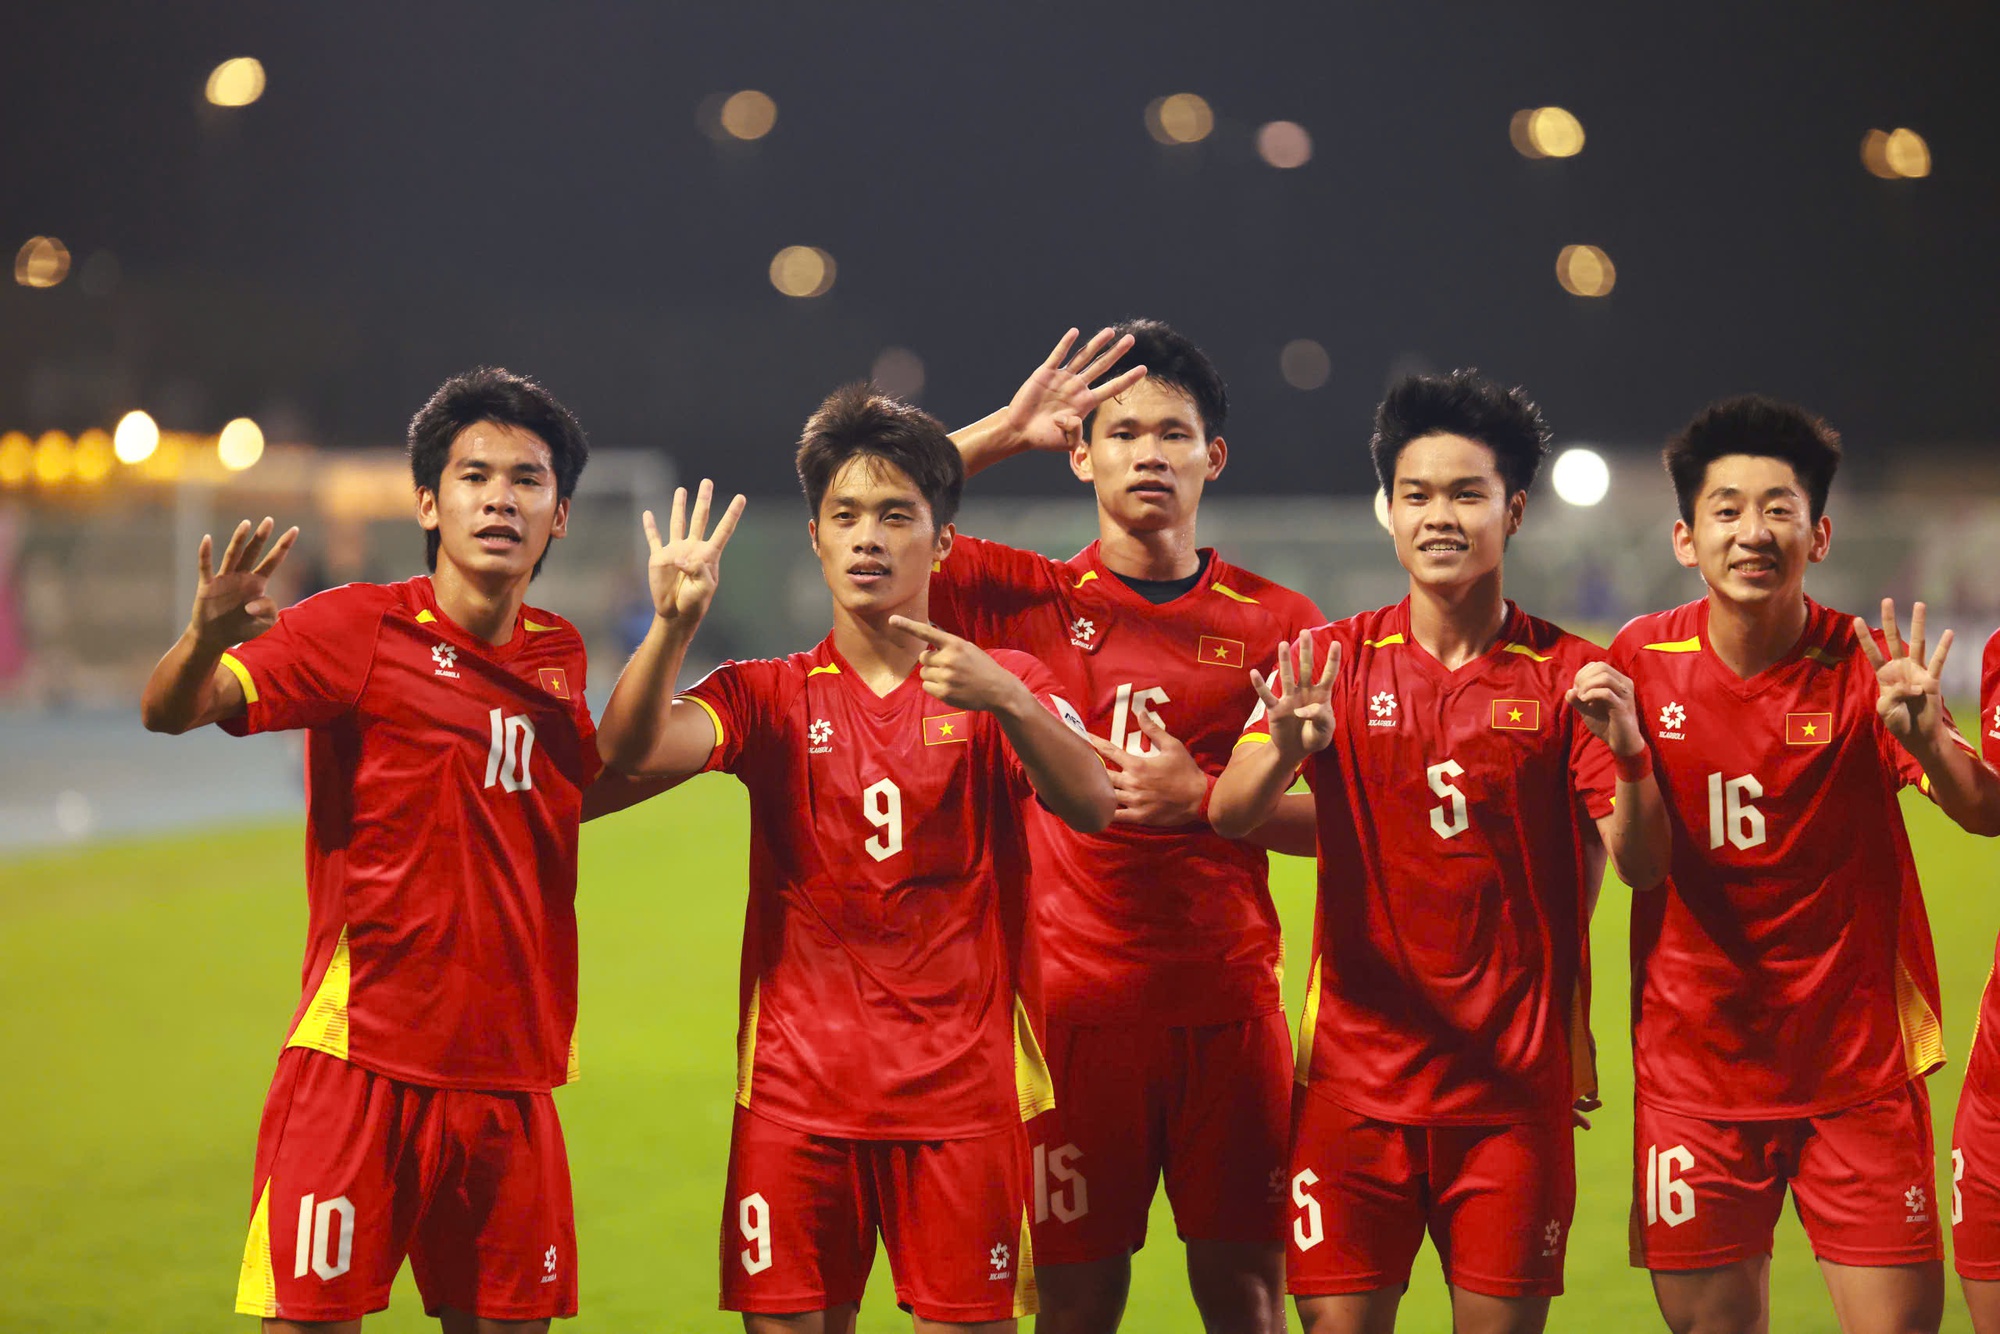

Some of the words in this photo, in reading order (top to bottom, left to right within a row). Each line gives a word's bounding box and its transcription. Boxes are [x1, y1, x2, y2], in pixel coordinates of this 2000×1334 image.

[485, 707, 535, 794] 10
[1110, 682, 1171, 759] 15
[863, 777, 903, 863] 9
[1427, 758, 1469, 840] 5
[1708, 771, 1766, 851] 16
[1033, 1142, 1089, 1225] 15
[1292, 1167, 1324, 1252] 5
[1647, 1144, 1696, 1228] 16
[294, 1193, 355, 1281] 10
[739, 1192, 773, 1276] 9
